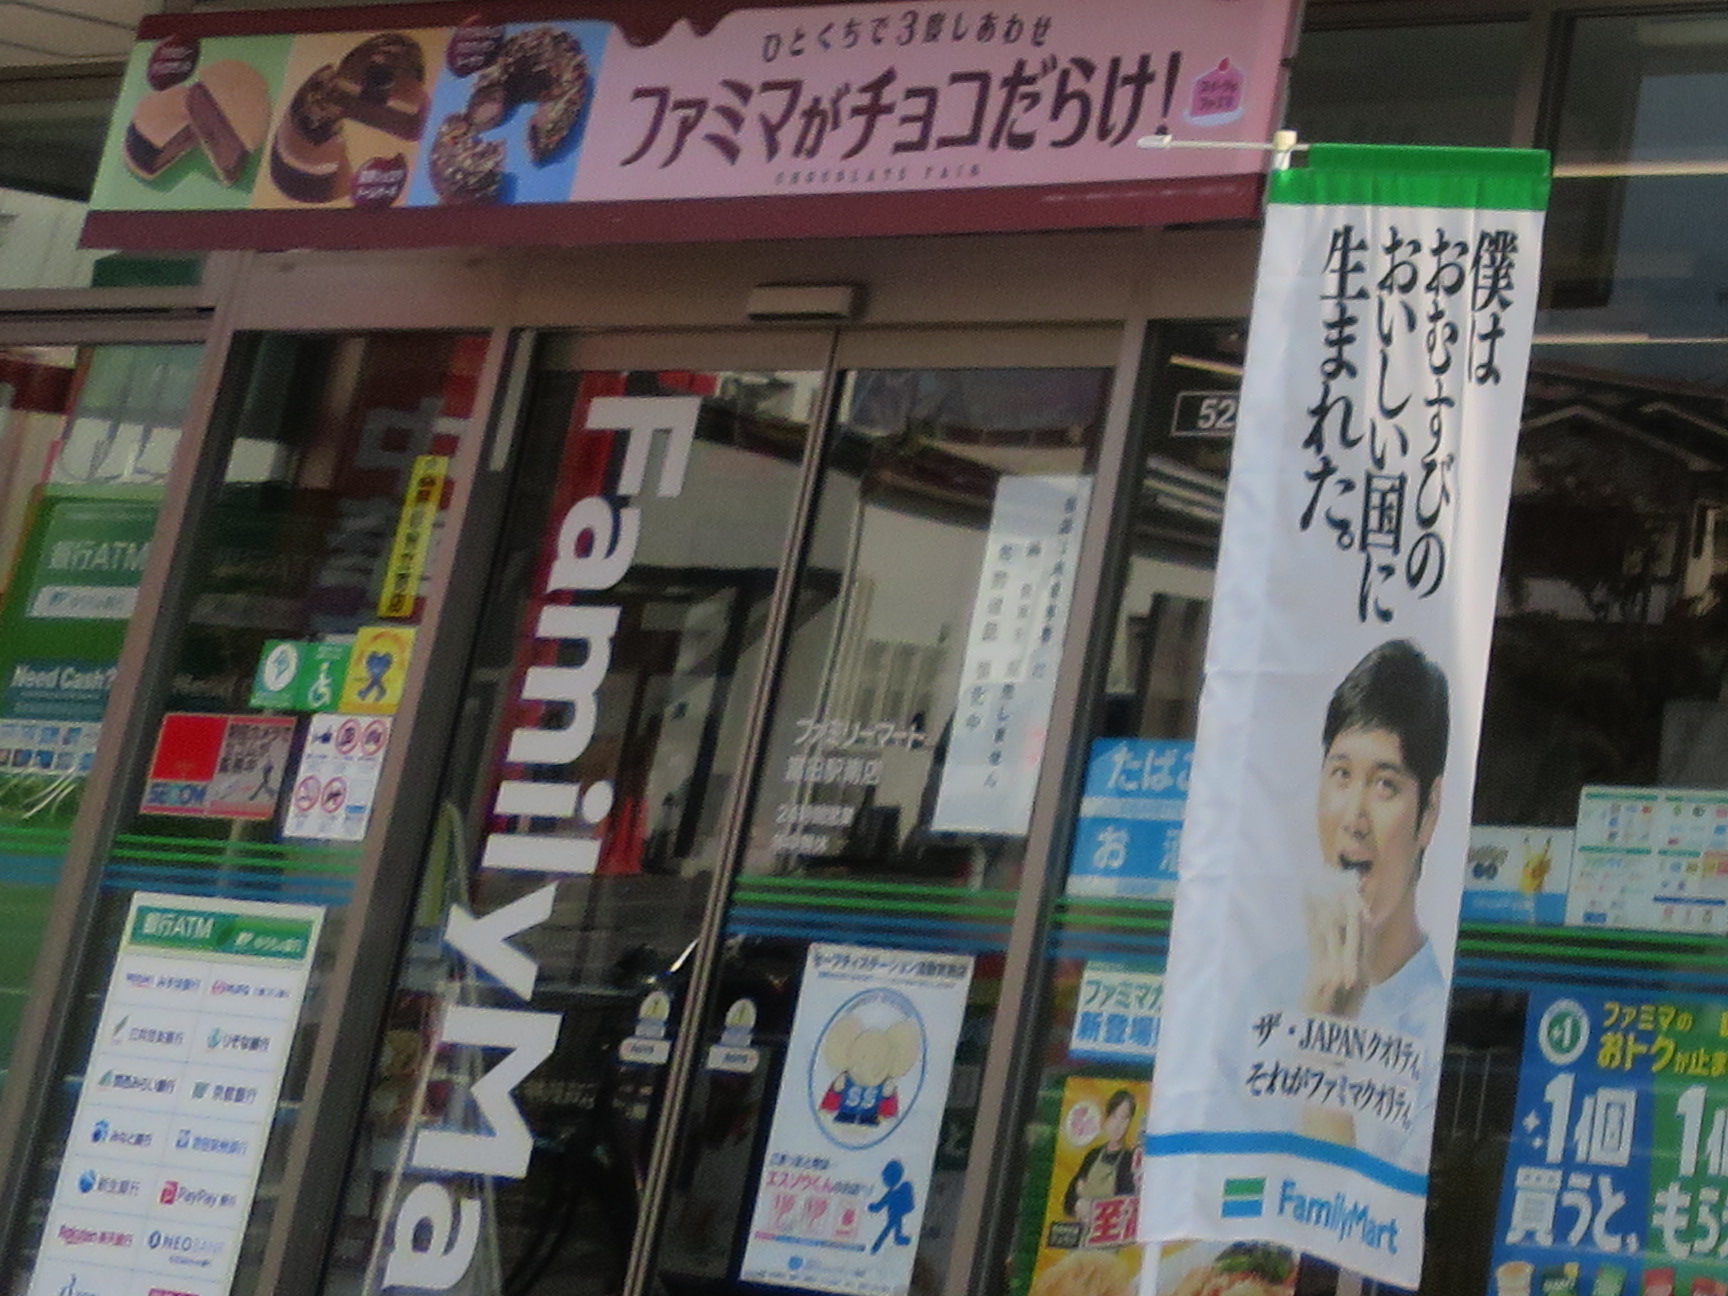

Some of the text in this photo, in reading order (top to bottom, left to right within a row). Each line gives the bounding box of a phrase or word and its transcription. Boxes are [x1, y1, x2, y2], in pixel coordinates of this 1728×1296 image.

[762, 9, 1053, 63] ひとくちで3度しあわせ
[620, 50, 1182, 168] ファミマがチョコだらけ!
[1468, 228, 1519, 386] 僕は
[1299, 224, 1371, 551] 生まれた。
[1358, 225, 1422, 623] おいしい国に
[1406, 227, 1469, 598] おむすびの
[1603, 1001, 1694, 1032] ファミマの
[1544, 1072, 1638, 1168] 1個
[1276, 1178, 1398, 1256] FamilyMart
[1505, 1167, 1640, 1254] 買うと、
